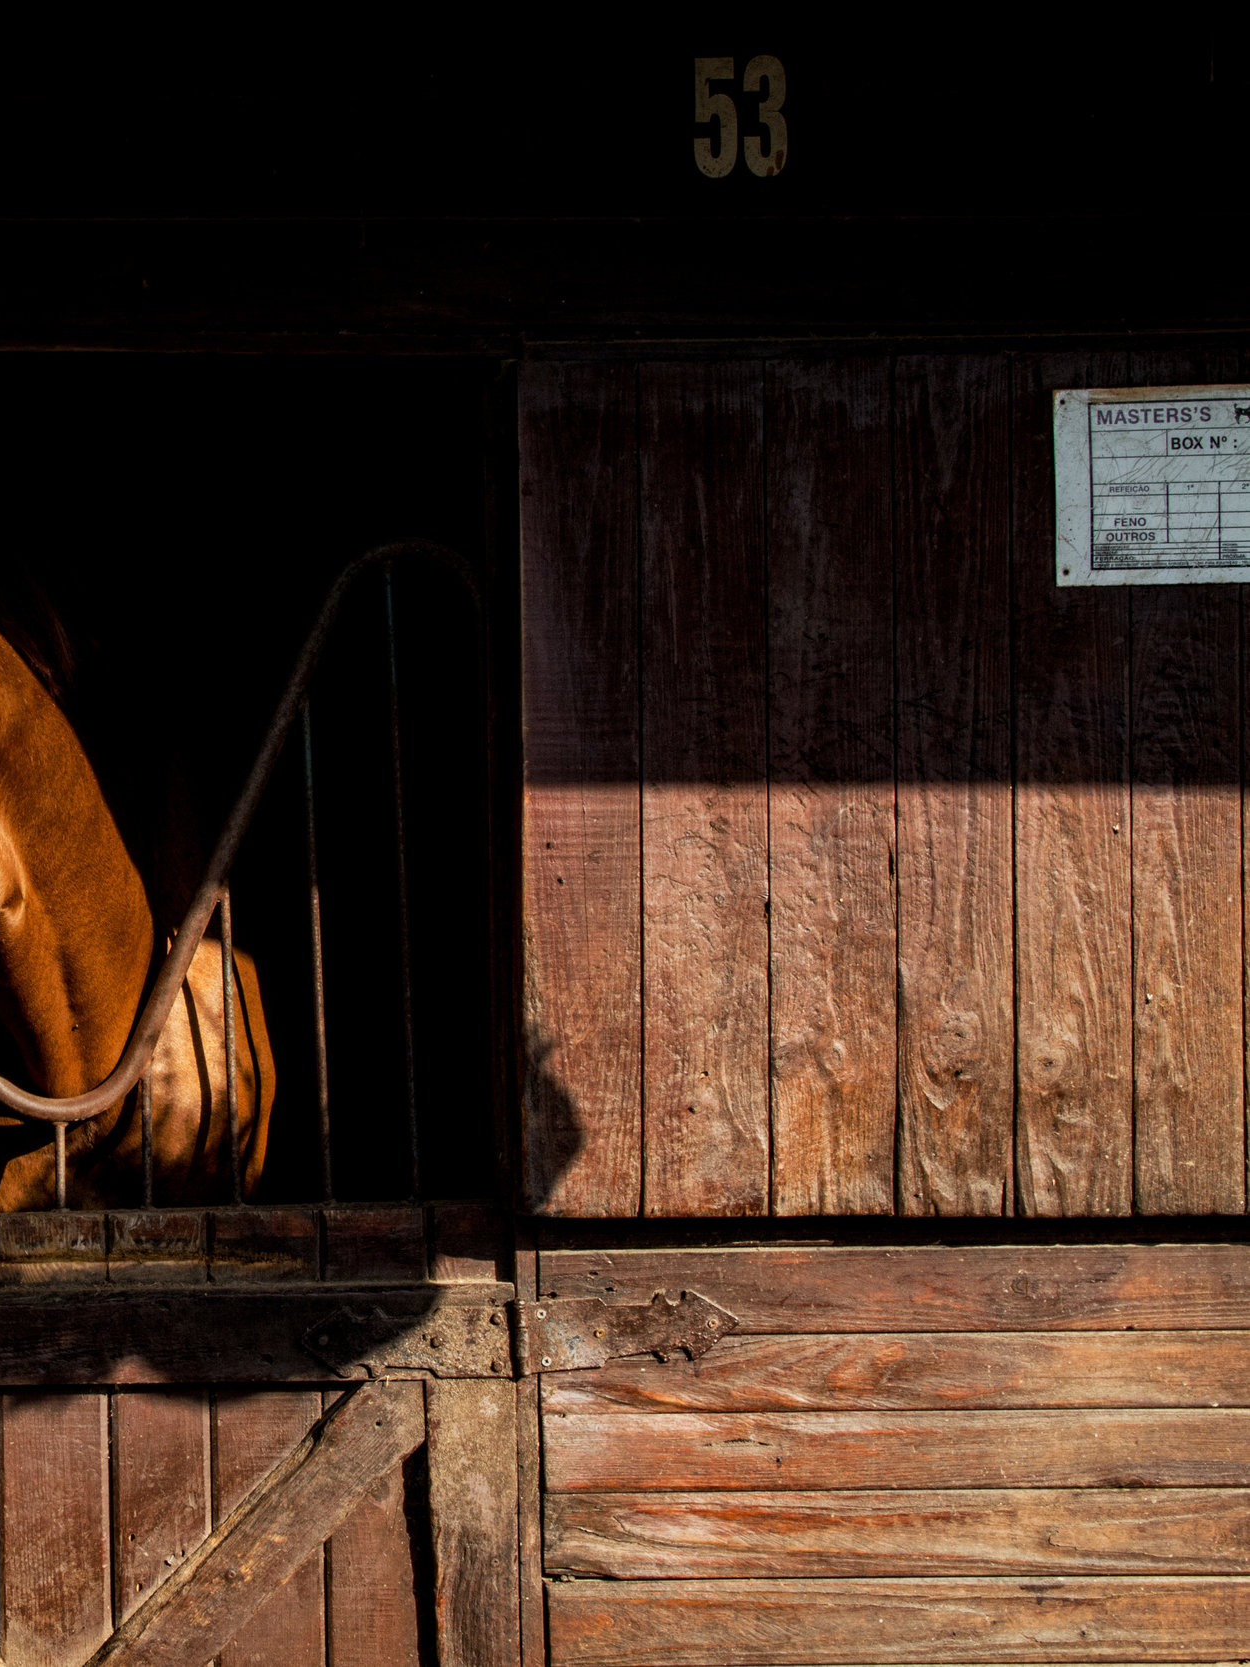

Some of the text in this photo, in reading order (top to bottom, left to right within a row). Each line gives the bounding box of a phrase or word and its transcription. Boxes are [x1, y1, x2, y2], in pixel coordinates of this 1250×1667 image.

[694, 54, 788, 179] 53
[1097, 406, 1212, 425] MASTERS'S
[1171, 437, 1204, 450] BOX
[1209, 435, 1227, 449] Nº
[1114, 517, 1147, 527] FENO
[1105, 531, 1156, 542] OUTROS
